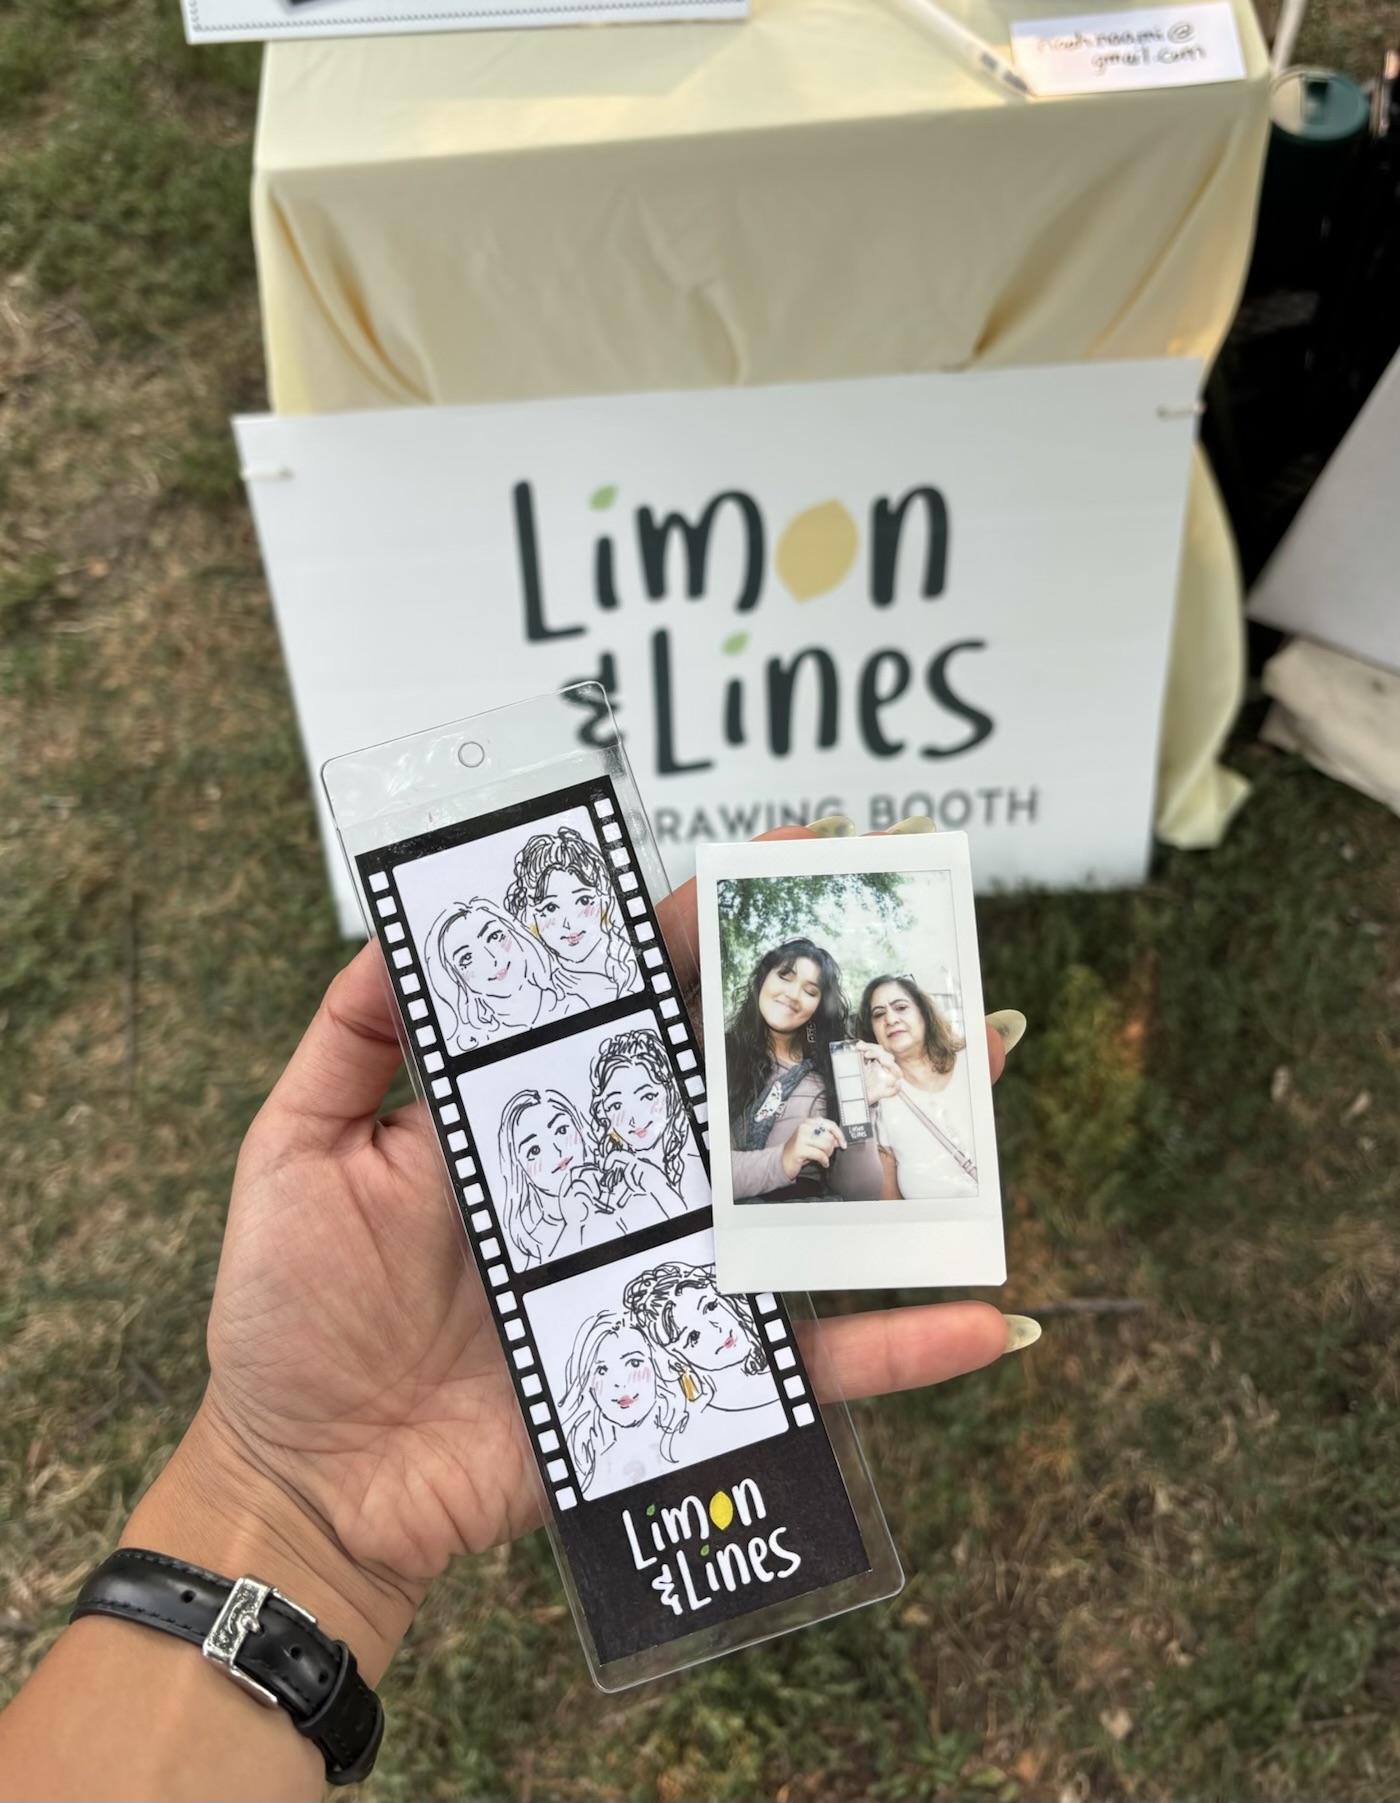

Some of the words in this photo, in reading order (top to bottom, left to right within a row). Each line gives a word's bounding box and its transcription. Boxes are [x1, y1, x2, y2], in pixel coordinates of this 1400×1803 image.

[512, 480, 952, 643] Limon
[559, 650, 626, 750] &
[651, 627, 995, 776] Lines
[869, 784, 1039, 831] BOOTH
[621, 1478, 767, 1570] Limon
[651, 1563, 683, 1615] &
[676, 1526, 801, 1610] Lines
